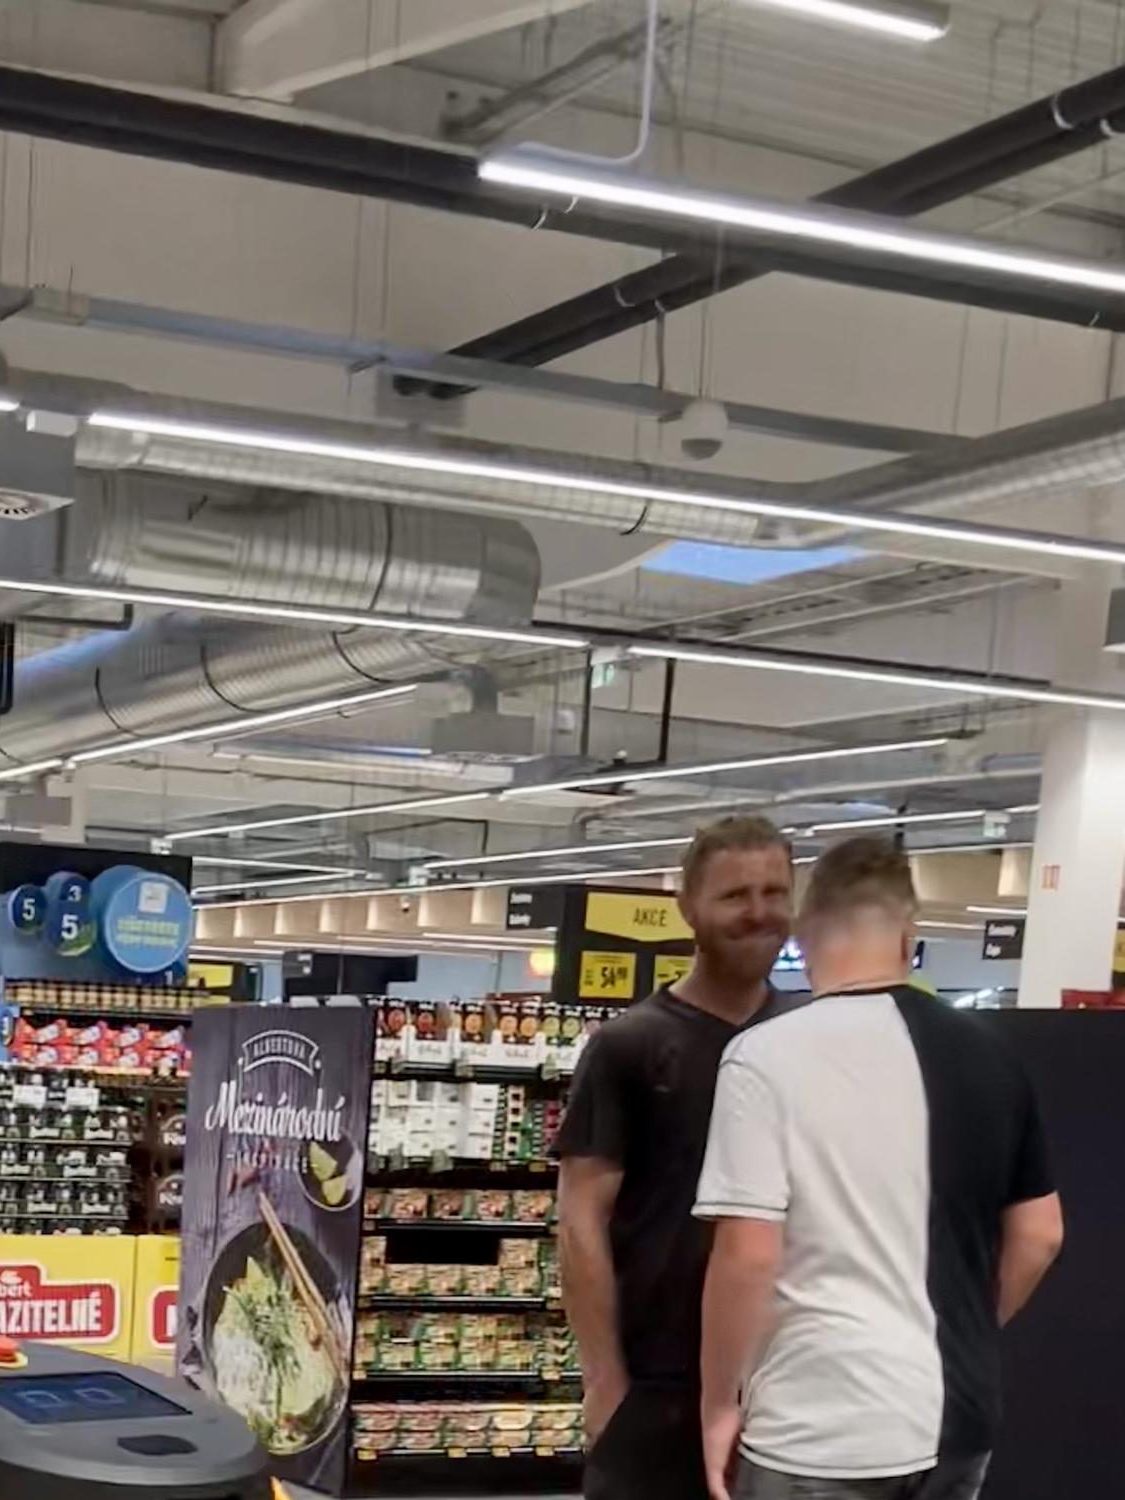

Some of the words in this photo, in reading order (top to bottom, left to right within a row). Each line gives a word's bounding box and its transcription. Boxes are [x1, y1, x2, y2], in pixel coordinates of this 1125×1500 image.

[22, 898, 36, 921] 5
[633, 906, 668, 928] AKCE
[61, 914, 78, 940] 5
